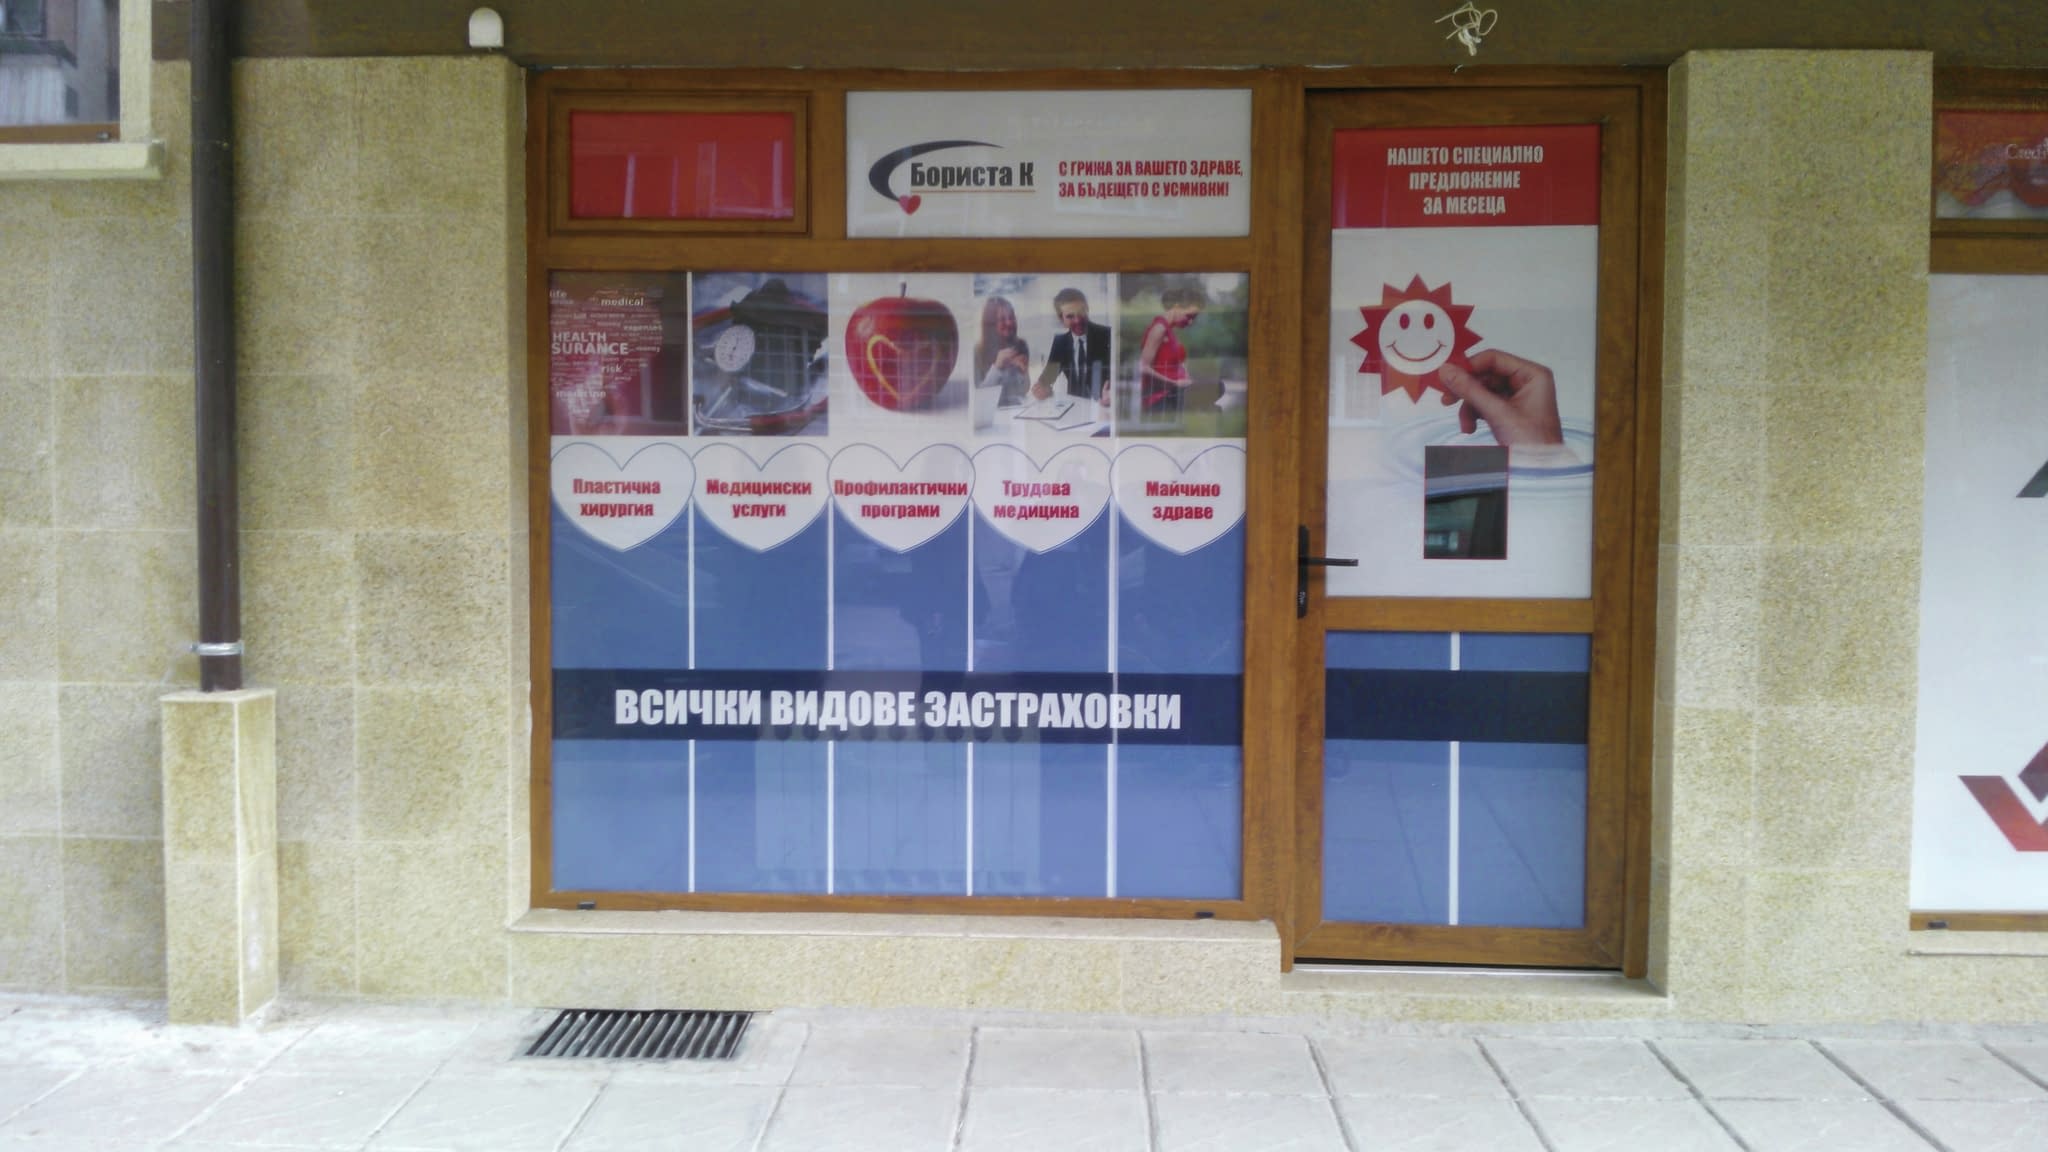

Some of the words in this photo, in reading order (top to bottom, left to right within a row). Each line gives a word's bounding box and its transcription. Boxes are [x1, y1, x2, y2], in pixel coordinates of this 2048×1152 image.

[1387, 147, 1449, 166] НАШЕТО
[1453, 145, 1544, 166] СПЕЦИАЛНО
[910, 162, 1013, 188] Бориста
[1019, 162, 1034, 186] К
[1059, 161, 1067, 176] С
[1070, 161, 1113, 176] ГРИЖА
[1116, 161, 1132, 176] ЗА
[1135, 160, 1187, 176] ВАШЕТО
[1190, 160, 1243, 178] ЗДРАВЕ,
[1059, 182, 1075, 197] ЗА
[1078, 182, 1149, 199] БЪДЕЩЕТО
[1152, 182, 1160, 197] С
[1162, 181, 1229, 197] УСМИВКИ!
[1409, 171, 1521, 192] ПРЕДЛОЖЕНИЕ
[1423, 196, 1443, 215] ЗА
[1446, 195, 1506, 216] МЕСЕЦА
[600, 297, 644, 306] medical
[552, 332, 607, 343] HEALTH
[551, 342, 629, 355] SURANCE
[601, 363, 622, 373] risk
[573, 478, 661, 495] Пластична
[706, 480, 812, 497] Медицински
[834, 480, 967, 498] Профилактични
[1002, 480, 1070, 498] Трудова
[1146, 480, 1220, 497] Майчино
[580, 502, 654, 518] хирургия
[732, 503, 786, 519] услуги
[861, 505, 940, 520] програми
[994, 505, 1080, 520] медицина
[1152, 505, 1213, 521] здраве
[614, 689, 761, 725] ВСИЧКИ
[769, 690, 915, 731] ВИДОВЕ
[924, 692, 1181, 730] ЗАСТРАХОВКИ
